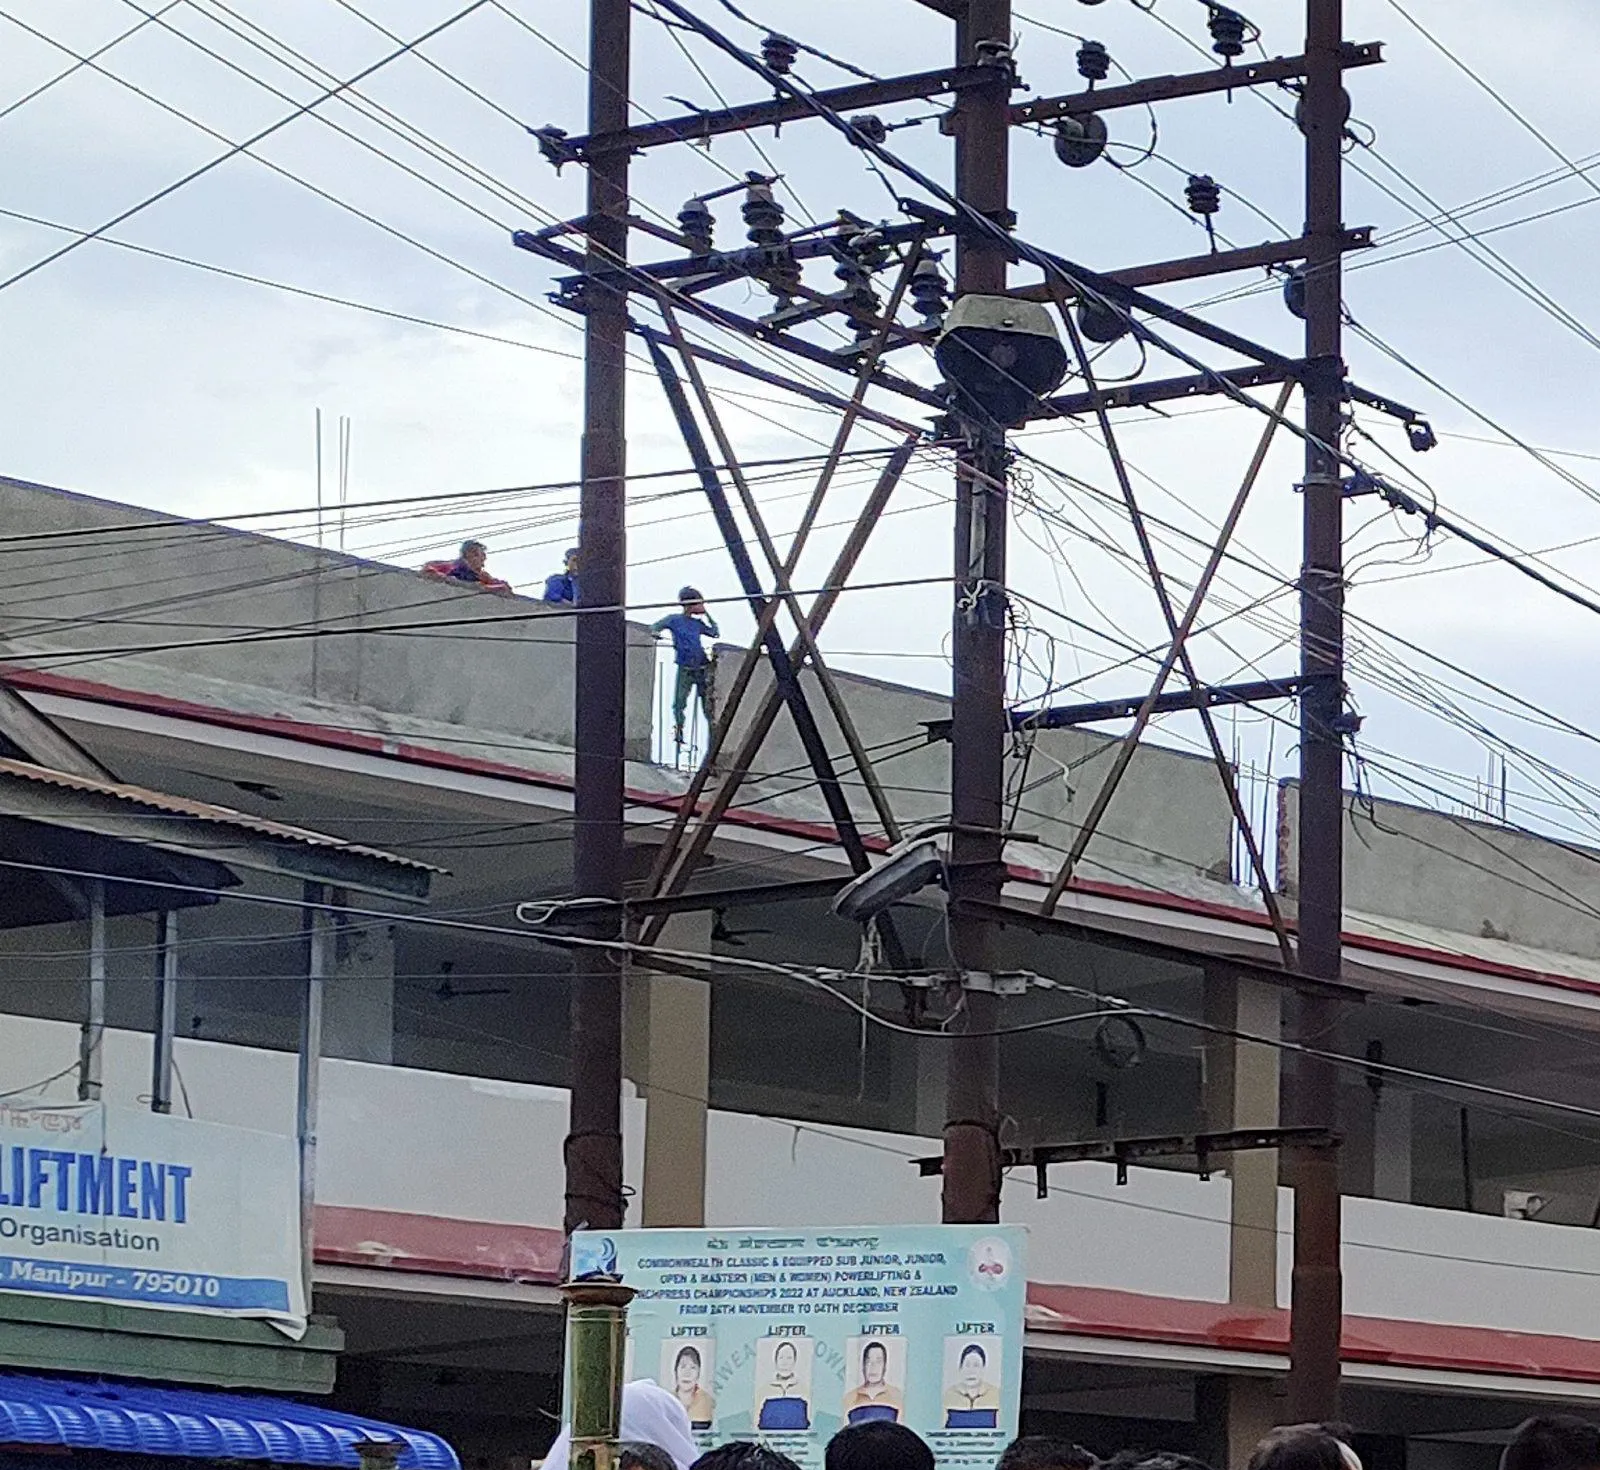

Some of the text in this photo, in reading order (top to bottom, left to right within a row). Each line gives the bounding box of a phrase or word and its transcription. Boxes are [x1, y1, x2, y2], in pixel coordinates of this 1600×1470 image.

[0, 1217, 160, 1252] Organisation
[637, 1257, 723, 1269] COMMONWEALTH
[726, 1256, 769, 1267] CLASSIC
[782, 1256, 833, 1267] EQUIPPED
[836, 1255, 857, 1265] SUB
[10, 1260, 112, 1289] Manipur
[132, 1271, 220, 1297] 795010
[660, 1273, 687, 1284] OPEN
[700, 1273, 748, 1284] MASTERS
[834, 1270, 911, 1282] POWERLIFTING
[693, 1288, 776, 1299] CHAMPIONSHIPS
[779, 1287, 803, 1299] 2022
[805, 1287, 819, 1297] AT
[822, 1286, 881, 1298] AUCKLAND,
[884, 1285, 907, 1297] NEW
[909, 1285, 958, 1296] ZEALAND
[679, 1304, 708, 1315] FROM
[738, 1303, 795, 1315] NOVEMBER
[798, 1303, 811, 1314] TO
[842, 1302, 899, 1313] DECEMBER
[670, 1326, 708, 1337] LIFTER
[768, 1325, 806, 1336] LIFTER
[861, 1324, 900, 1335] LIFTER
[955, 1322, 995, 1335] LIFTER
